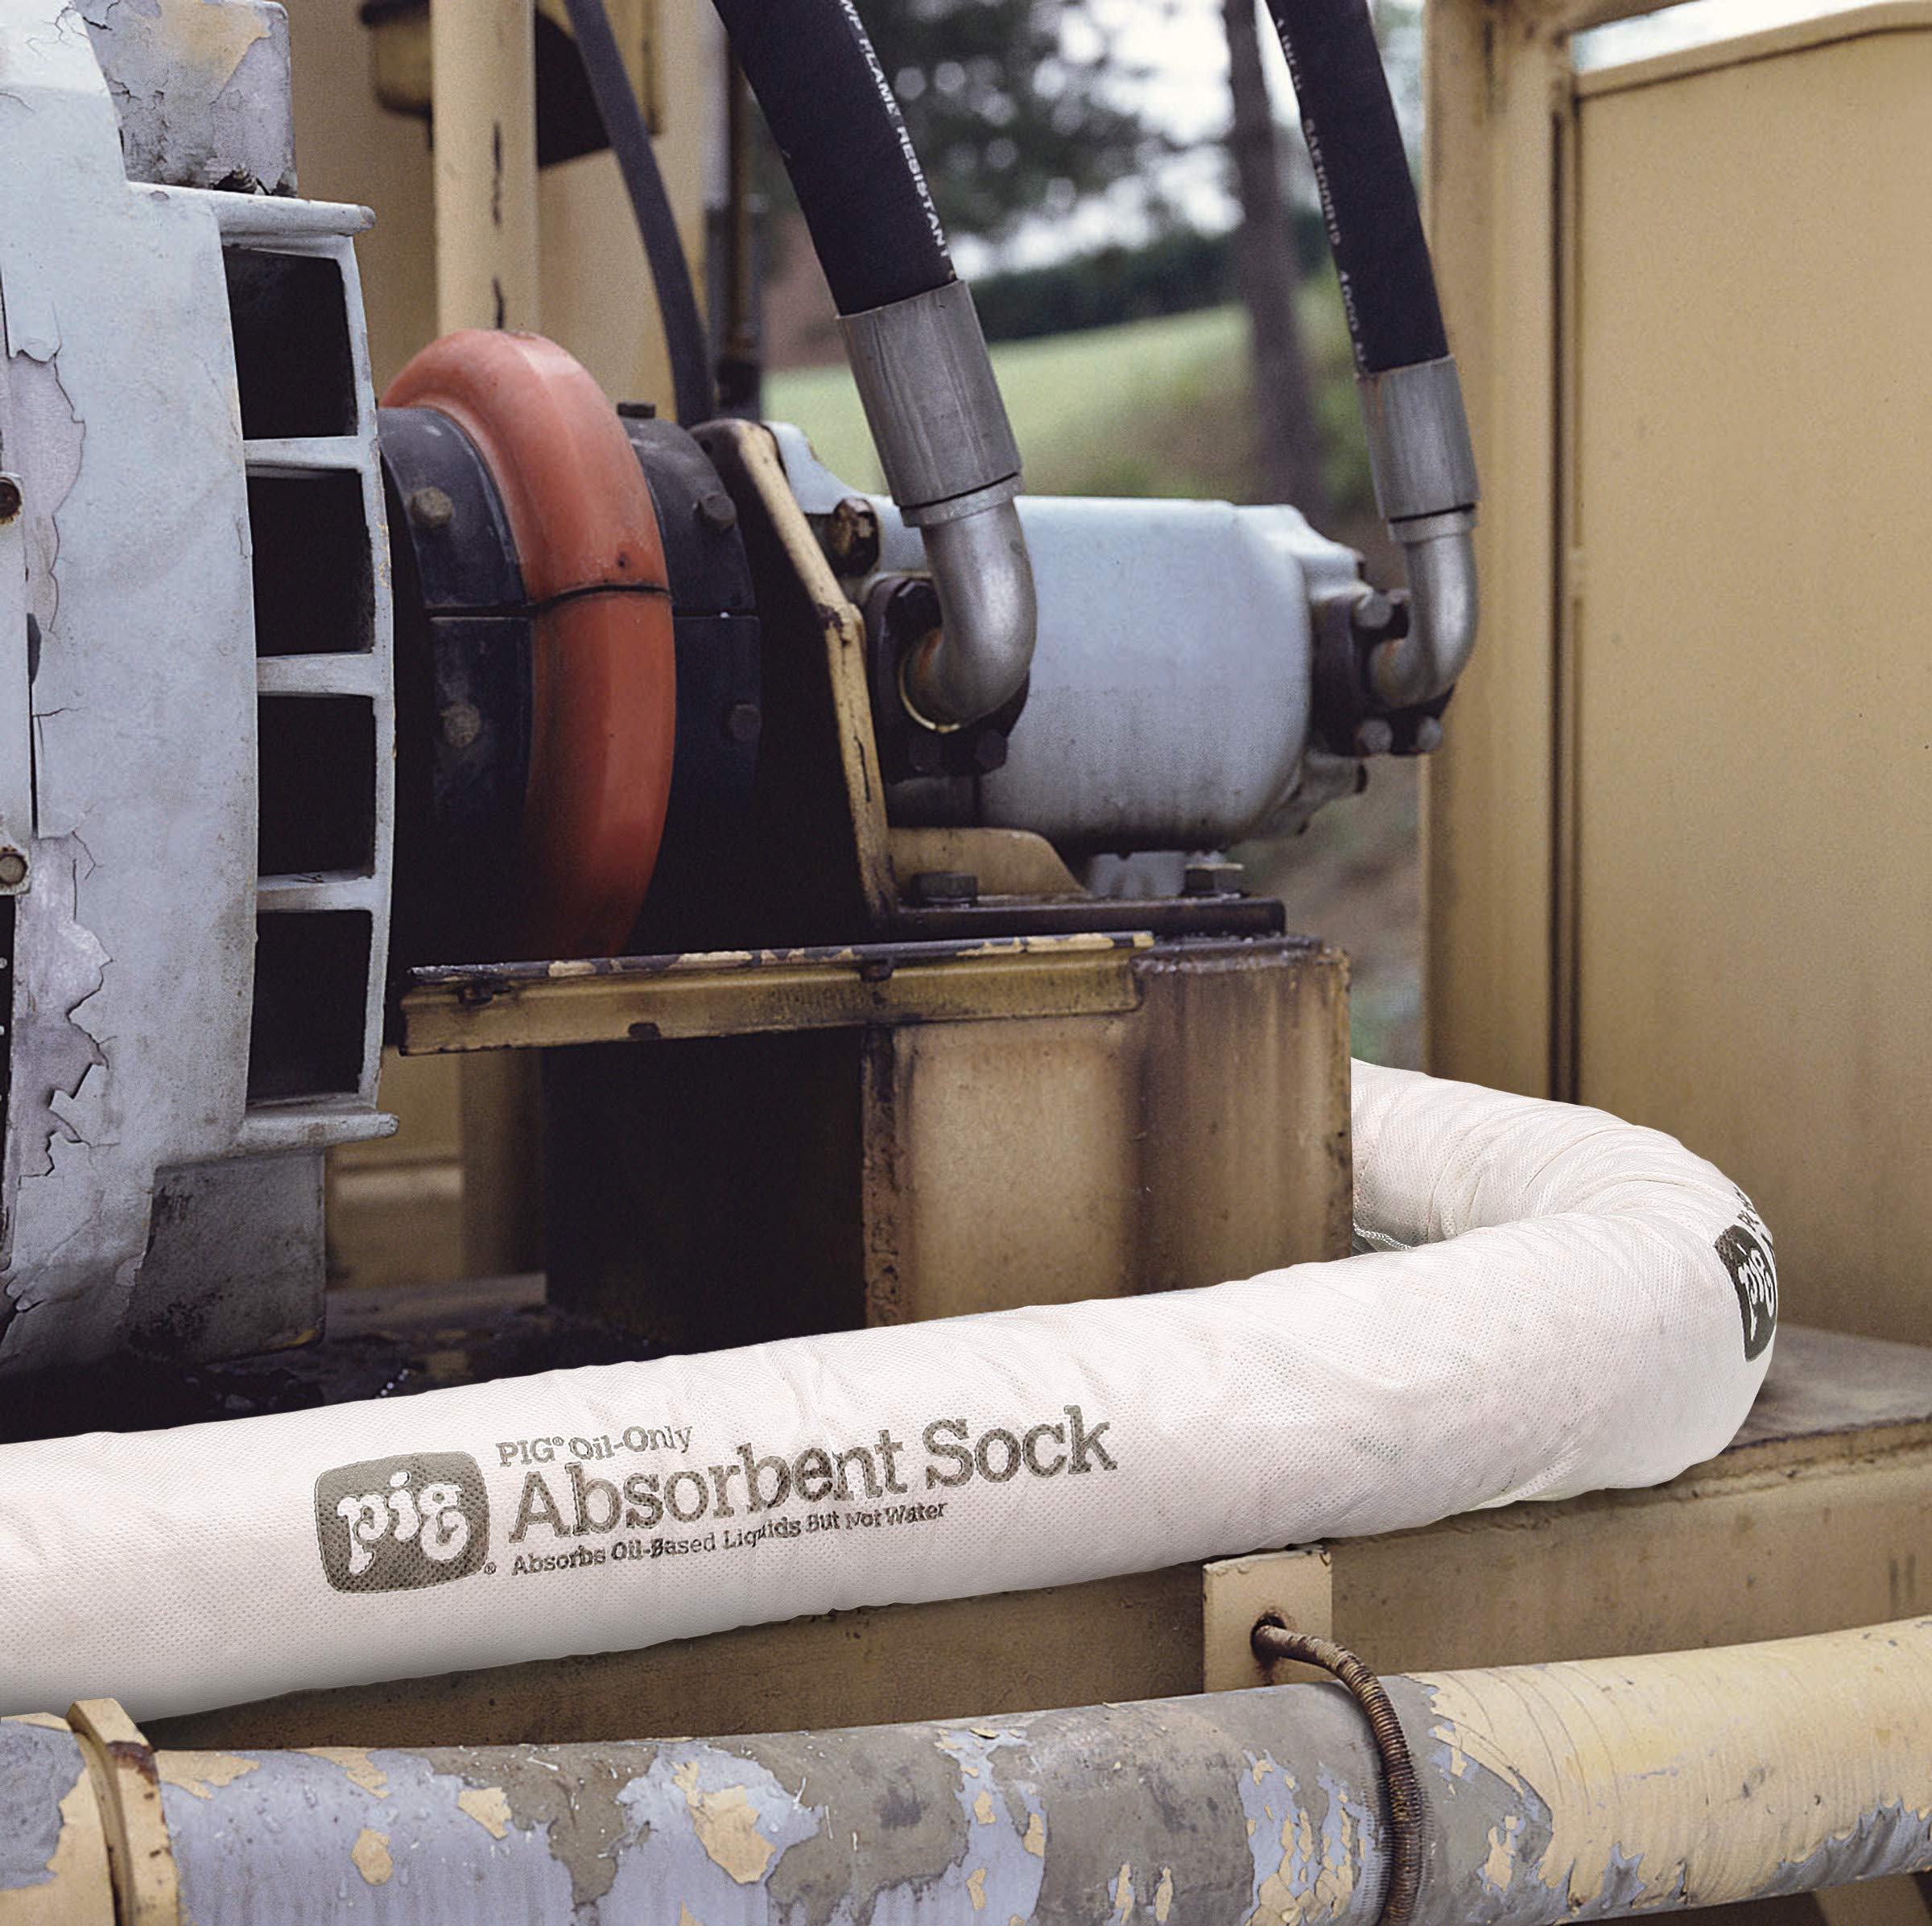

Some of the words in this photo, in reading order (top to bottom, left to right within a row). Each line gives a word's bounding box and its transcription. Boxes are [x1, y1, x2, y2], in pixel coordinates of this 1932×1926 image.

[858, 39, 901, 117] FLAME
[897, 126, 949, 258] RESISTANT
[508, 1428, 908, 1543] Absorbent
[922, 1404, 1118, 1490] Sock
[568, 1424, 693, 1462] Oil-Only
[336, 1470, 470, 1576] pig
[511, 1544, 605, 1576] Absorbs
[610, 1531, 716, 1564] Oil-Based
[723, 1515, 802, 1549] Liquids
[806, 1509, 840, 1535] But
[845, 1507, 882, 1530] Not
[885, 1499, 949, 1527] Water
